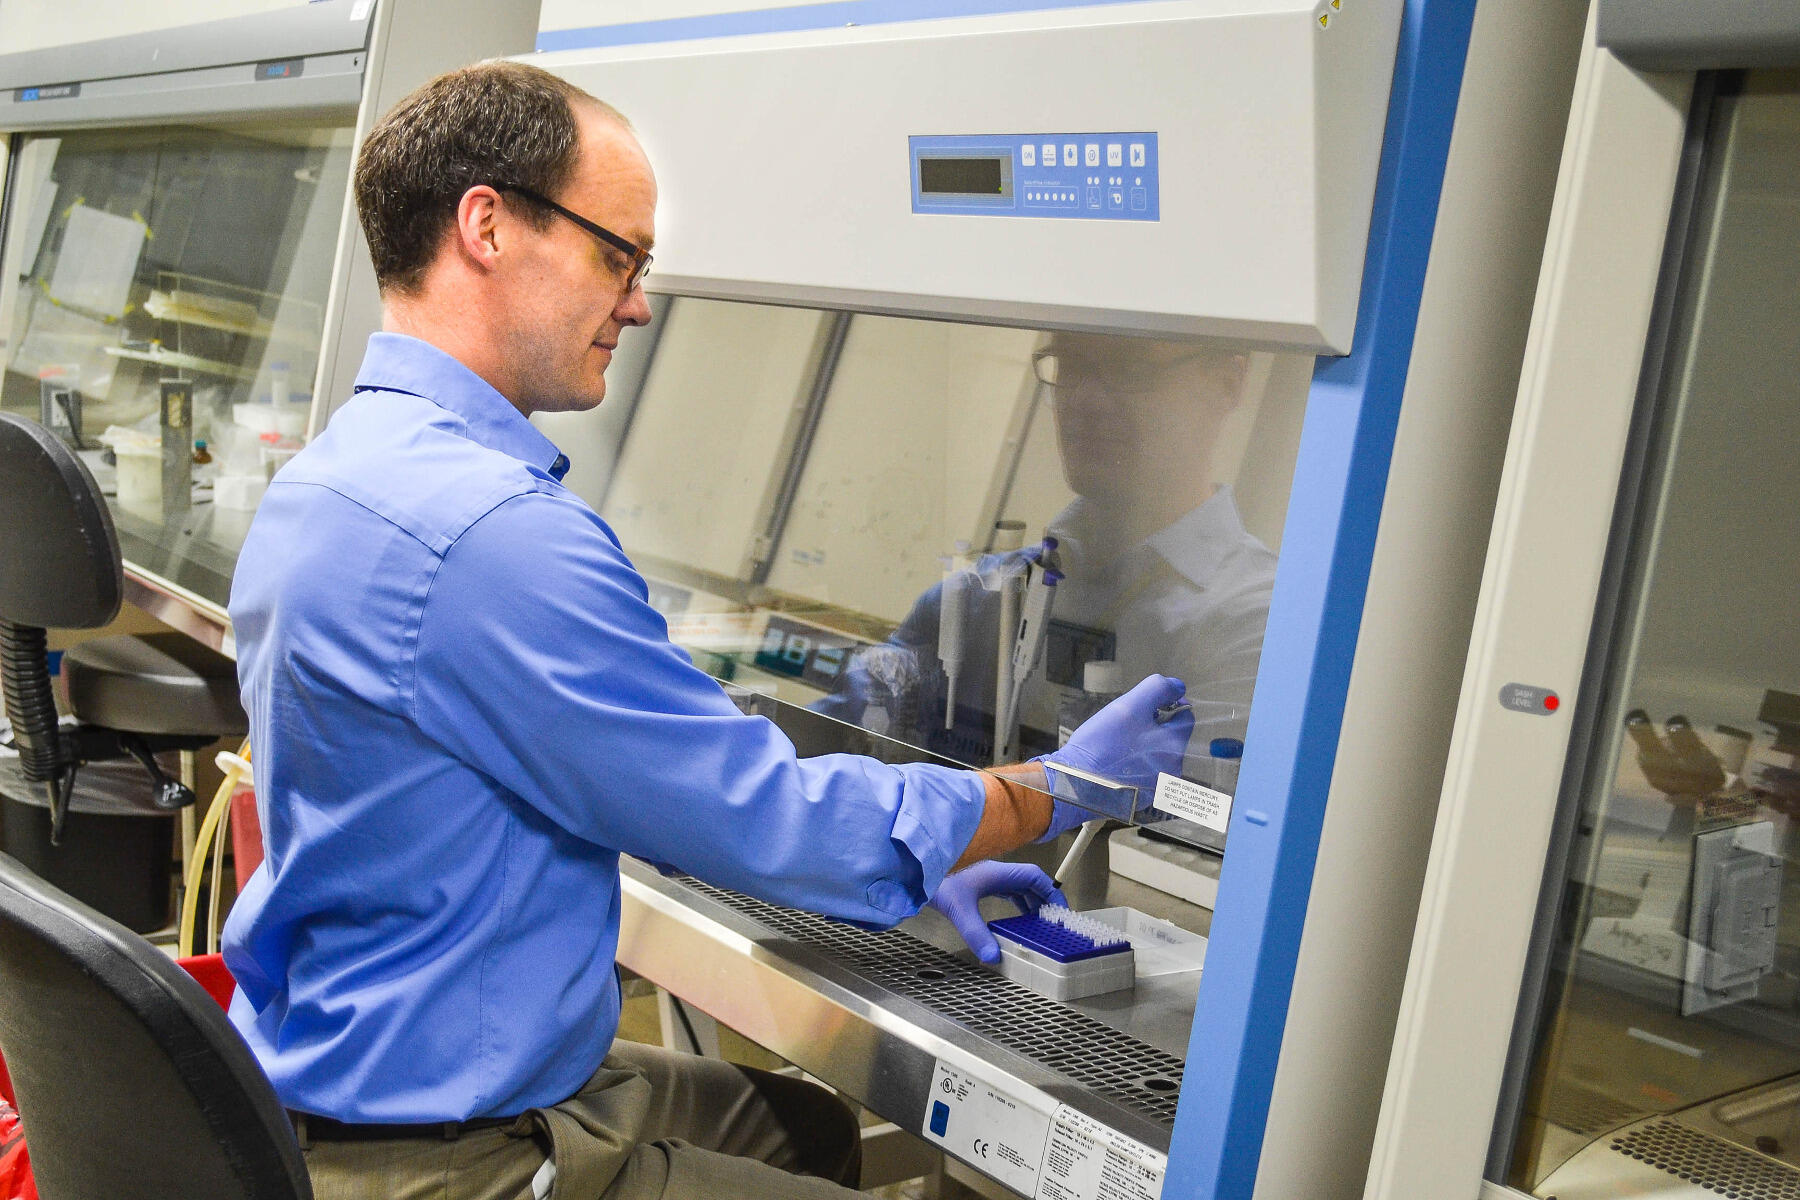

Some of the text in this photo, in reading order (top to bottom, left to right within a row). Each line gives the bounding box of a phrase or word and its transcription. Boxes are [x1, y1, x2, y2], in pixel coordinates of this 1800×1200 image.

[1182, 783, 1199, 794] CONTAIN
[1164, 793, 1183, 803] RECYCLE
[1189, 800, 1206, 812] DISPOSE
[1188, 793, 1201, 802] LAMPS
[1170, 802, 1208, 820] HAZARDOUS WASTE
